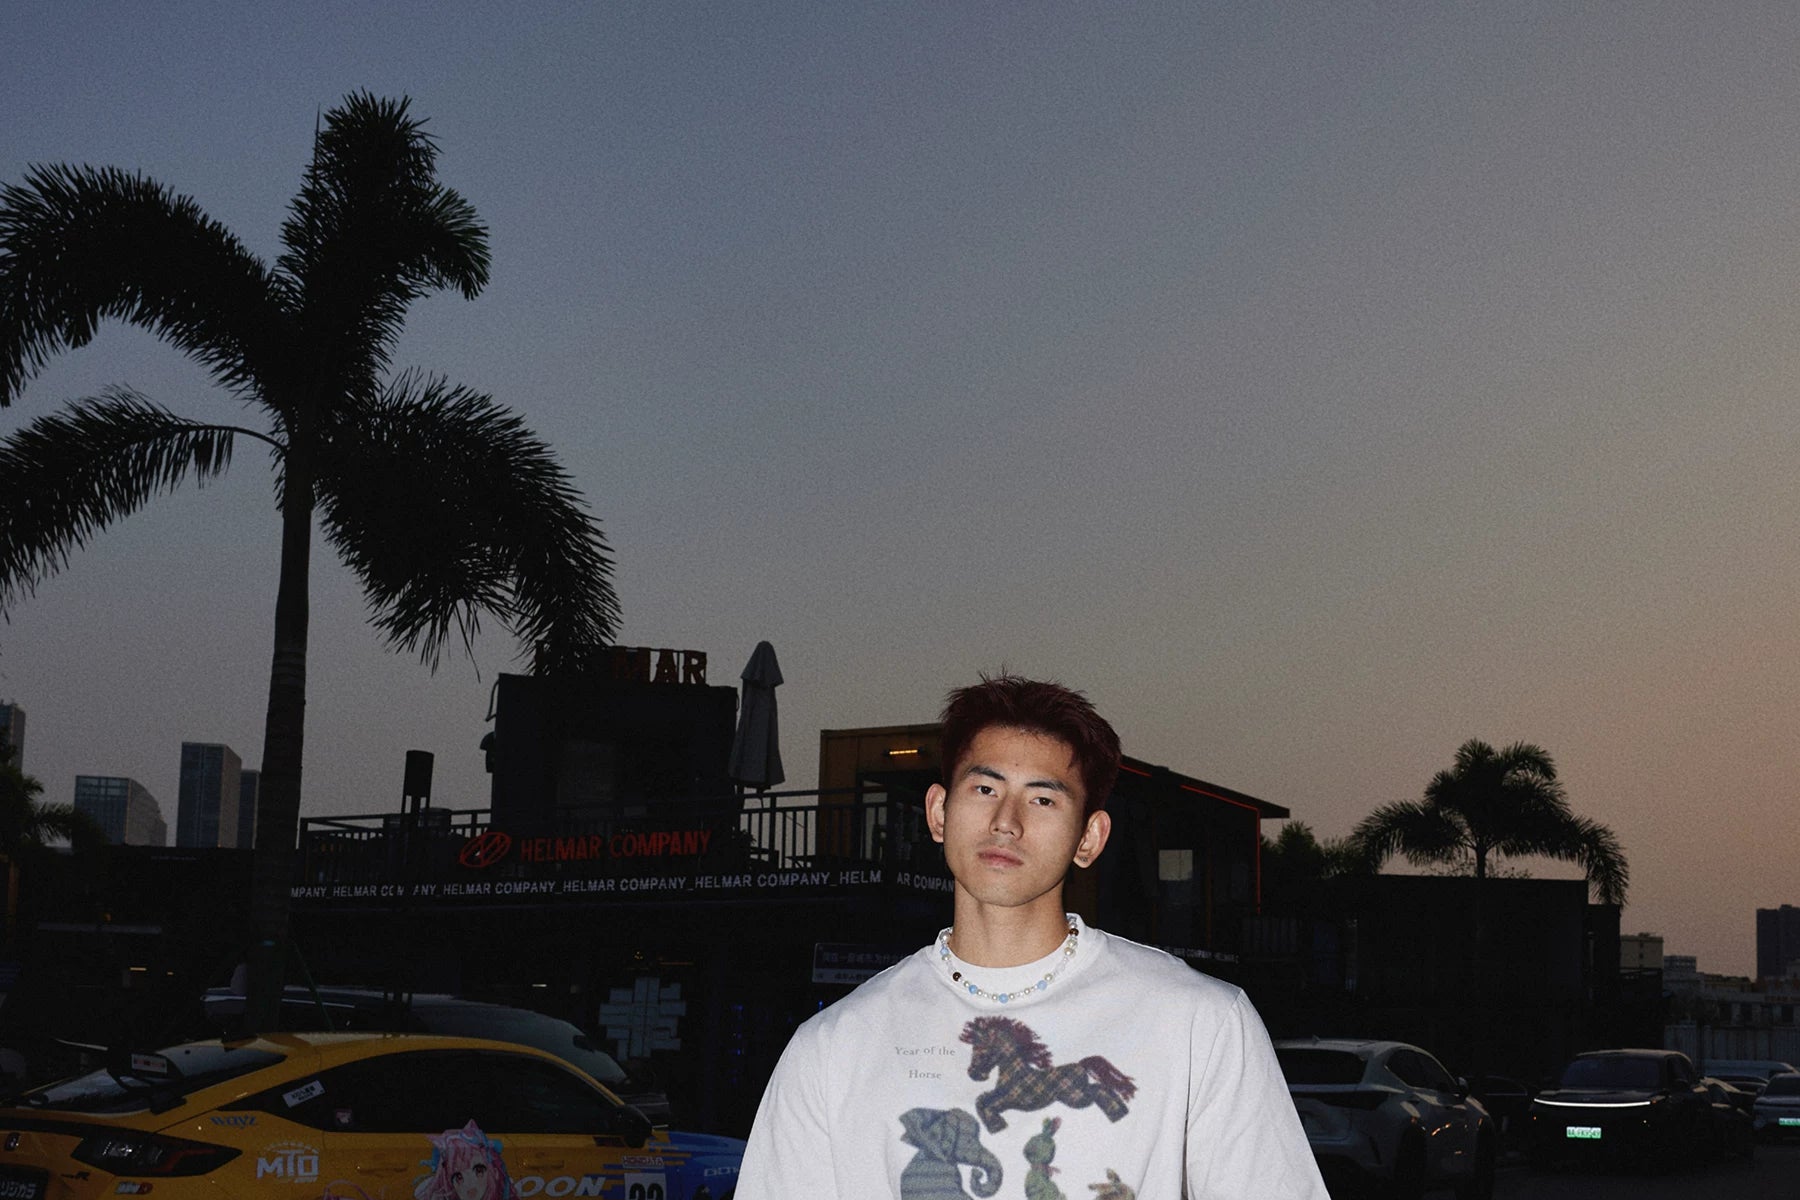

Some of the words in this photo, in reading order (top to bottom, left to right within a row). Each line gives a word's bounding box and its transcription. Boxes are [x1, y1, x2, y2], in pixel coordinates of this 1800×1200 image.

[520, 836, 603, 862] HELMAR
[609, 831, 713, 859] COMPANY
[913, 875, 954, 893] COMPAN
[895, 1046, 920, 1056] Year
[923, 1046, 936, 1056] of
[939, 1046, 956, 1056] the
[909, 1069, 942, 1080] Horse
[514, 1176, 606, 1198] OON
